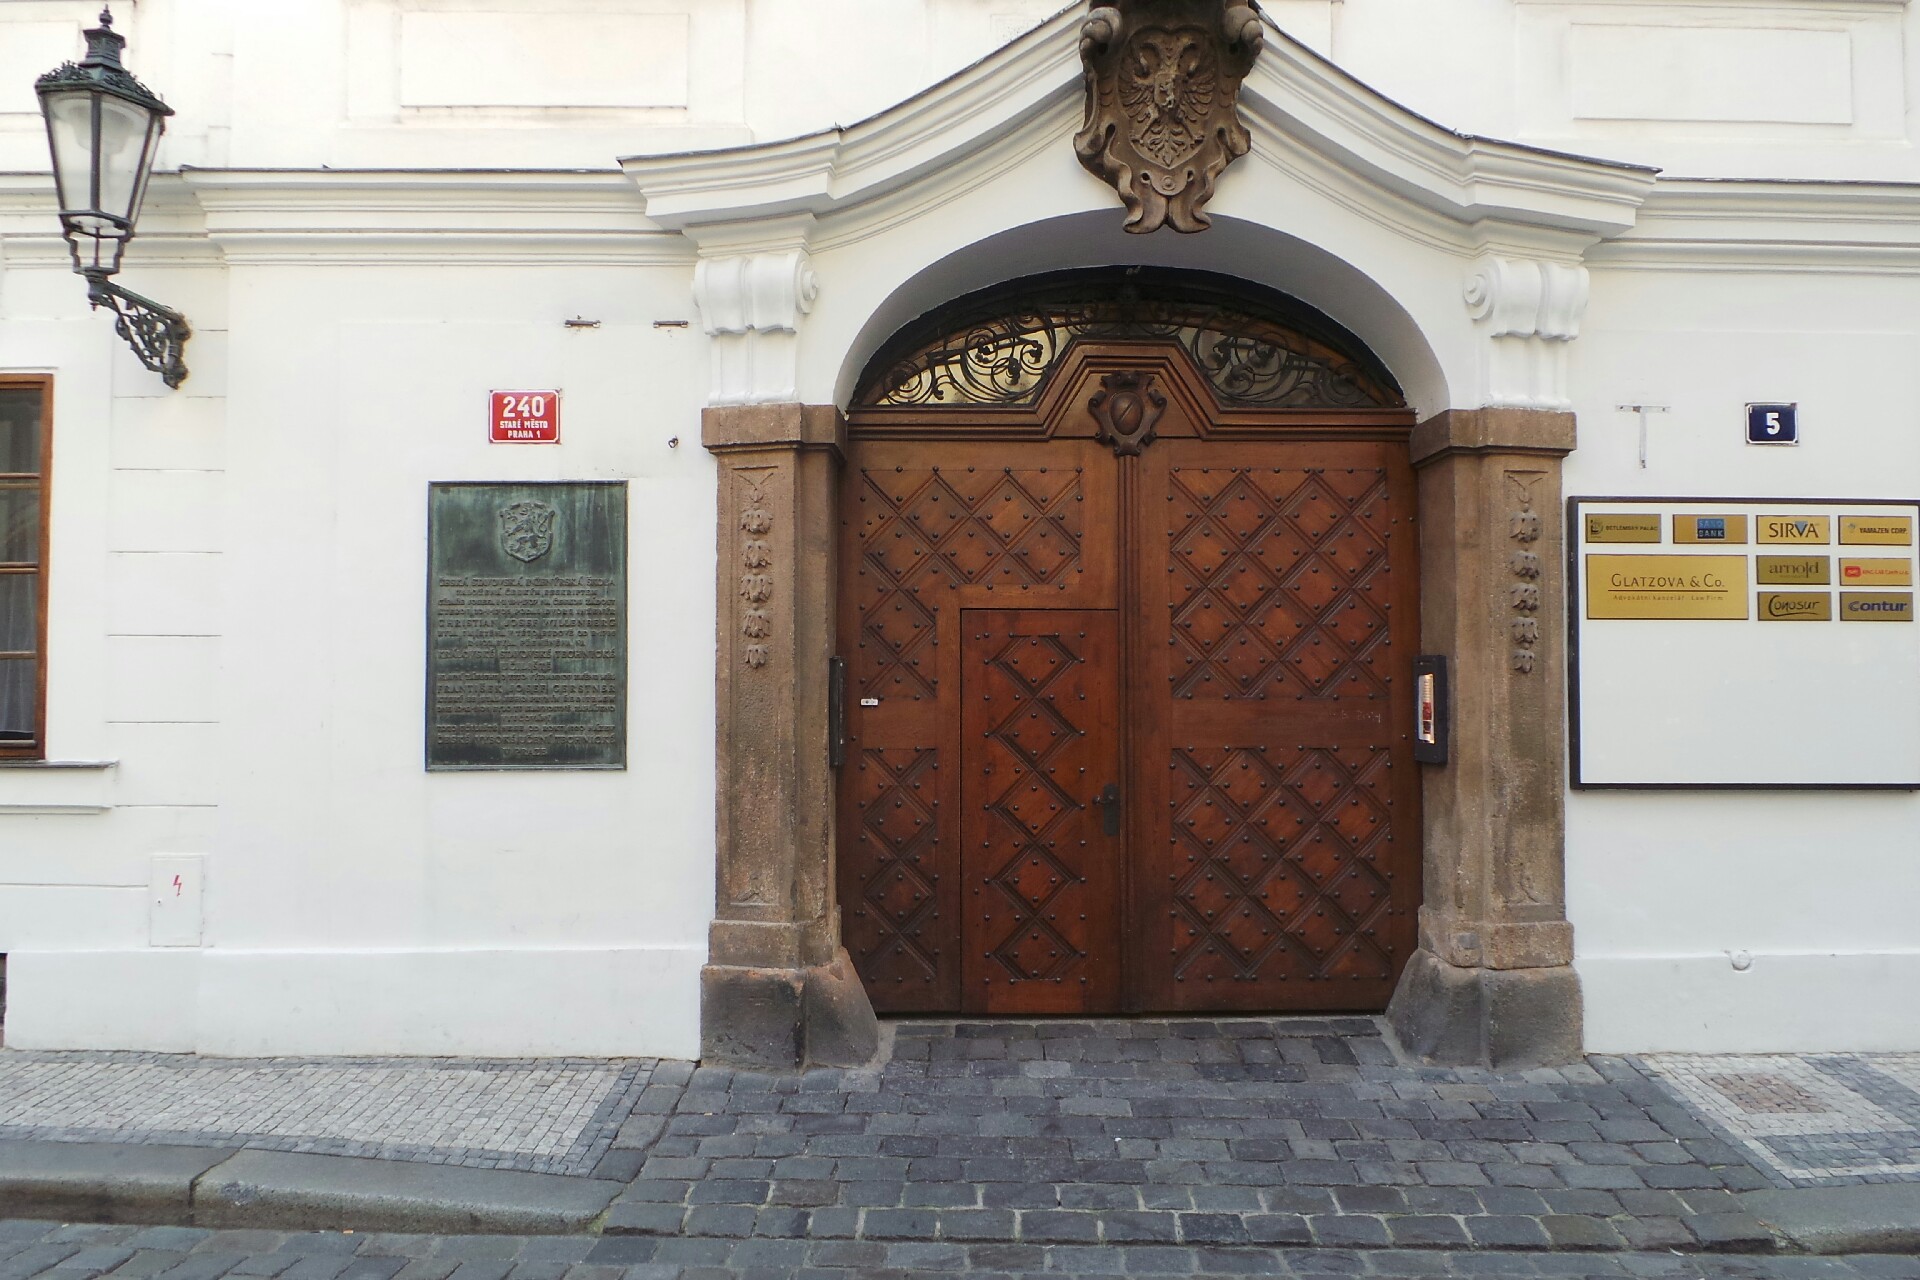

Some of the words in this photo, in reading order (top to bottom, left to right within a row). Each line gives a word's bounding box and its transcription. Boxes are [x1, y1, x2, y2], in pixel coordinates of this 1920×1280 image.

[502, 396, 544, 417] 240
[500, 419, 521, 428] STARÉ
[524, 419, 548, 428] MĚSTO
[1766, 412, 1780, 434] 5
[508, 430, 533, 438] PRAHA
[536, 430, 541, 438] 1
[1699, 529, 1724, 537] BANK
[1769, 522, 1819, 538] SIRVA
[1690, 576, 1700, 588] &
[1849, 601, 1907, 612] Contur
[438, 619, 496, 628] CHRISTIAN
[504, 619, 538, 628] JOSEF
[544, 619, 616, 628] WILLENBERG
[438, 683, 502, 694] FRANTIŠEK
[508, 684, 546, 694] JOSEF
[554, 684, 616, 694] GERSTNER
